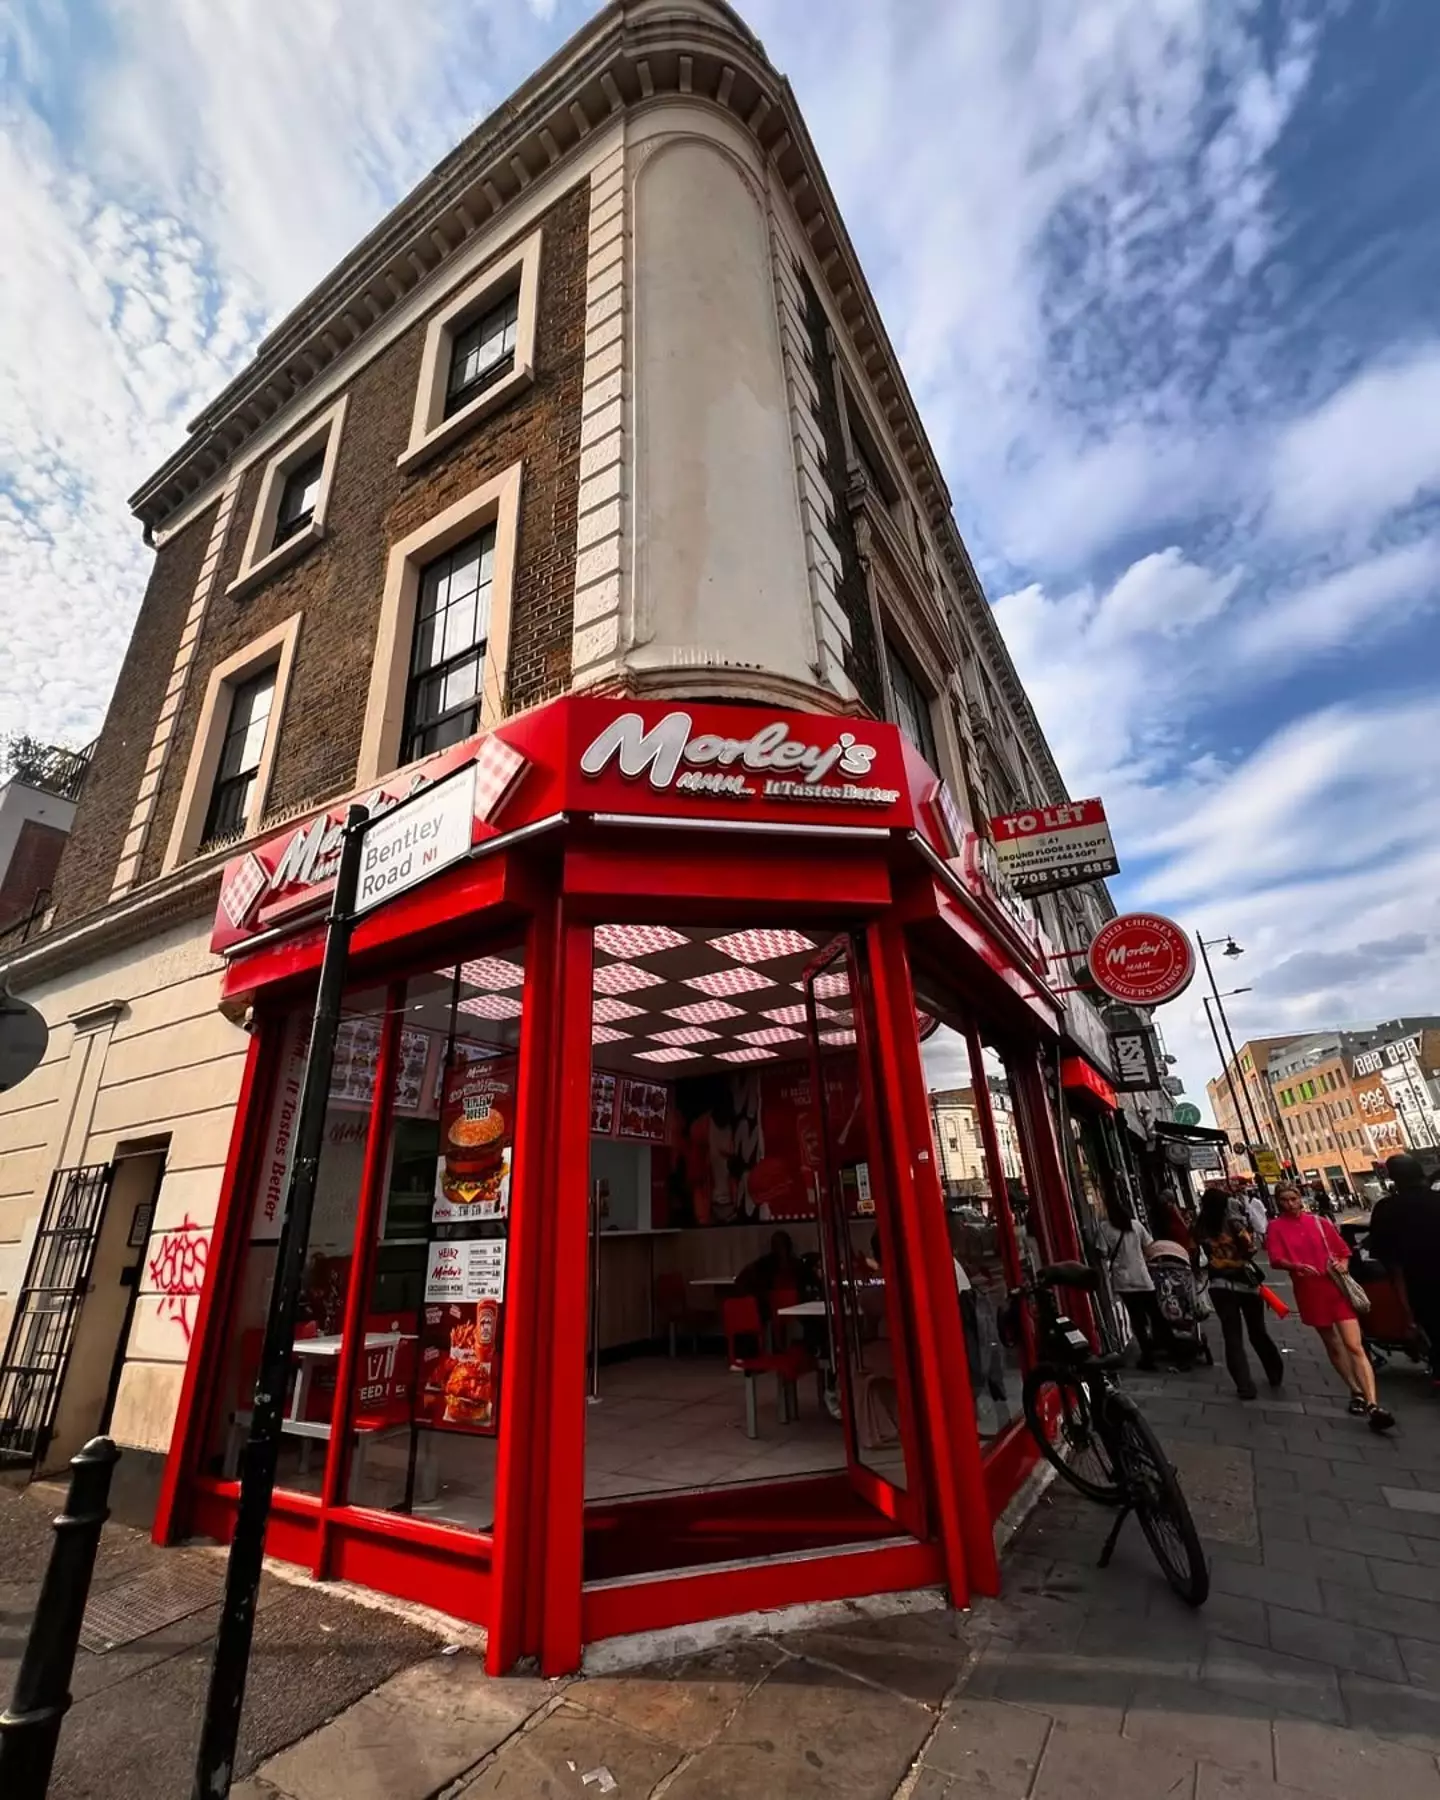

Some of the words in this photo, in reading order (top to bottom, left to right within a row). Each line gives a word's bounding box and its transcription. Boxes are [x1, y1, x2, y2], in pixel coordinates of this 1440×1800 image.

[580, 712, 876, 788] Morley's
[780, 781, 841, 798] Tastes
[842, 784, 900, 803] Better
[1003, 816, 1037, 834] TO
[1043, 805, 1085, 827] LET
[365, 813, 444, 872] Bentley
[998, 851, 1034, 863] GROUND
[1036, 845, 1064, 856] FLOOR
[362, 852, 413, 899] Road
[1010, 856, 1054, 869] BASEMENT
[1051, 866, 1078, 880] 131
[1083, 861, 1112, 874] 485
[1098, 924, 1122, 949] FRIED
[1125, 918, 1174, 938] CHICKEN
[1107, 939, 1170, 965] Morley's
[1104, 975, 1153, 997] BURGERS
[1155, 963, 1184, 991] WINGS
[275, 1100, 297, 1155] Tastes
[264, 1162, 286, 1222] Better
